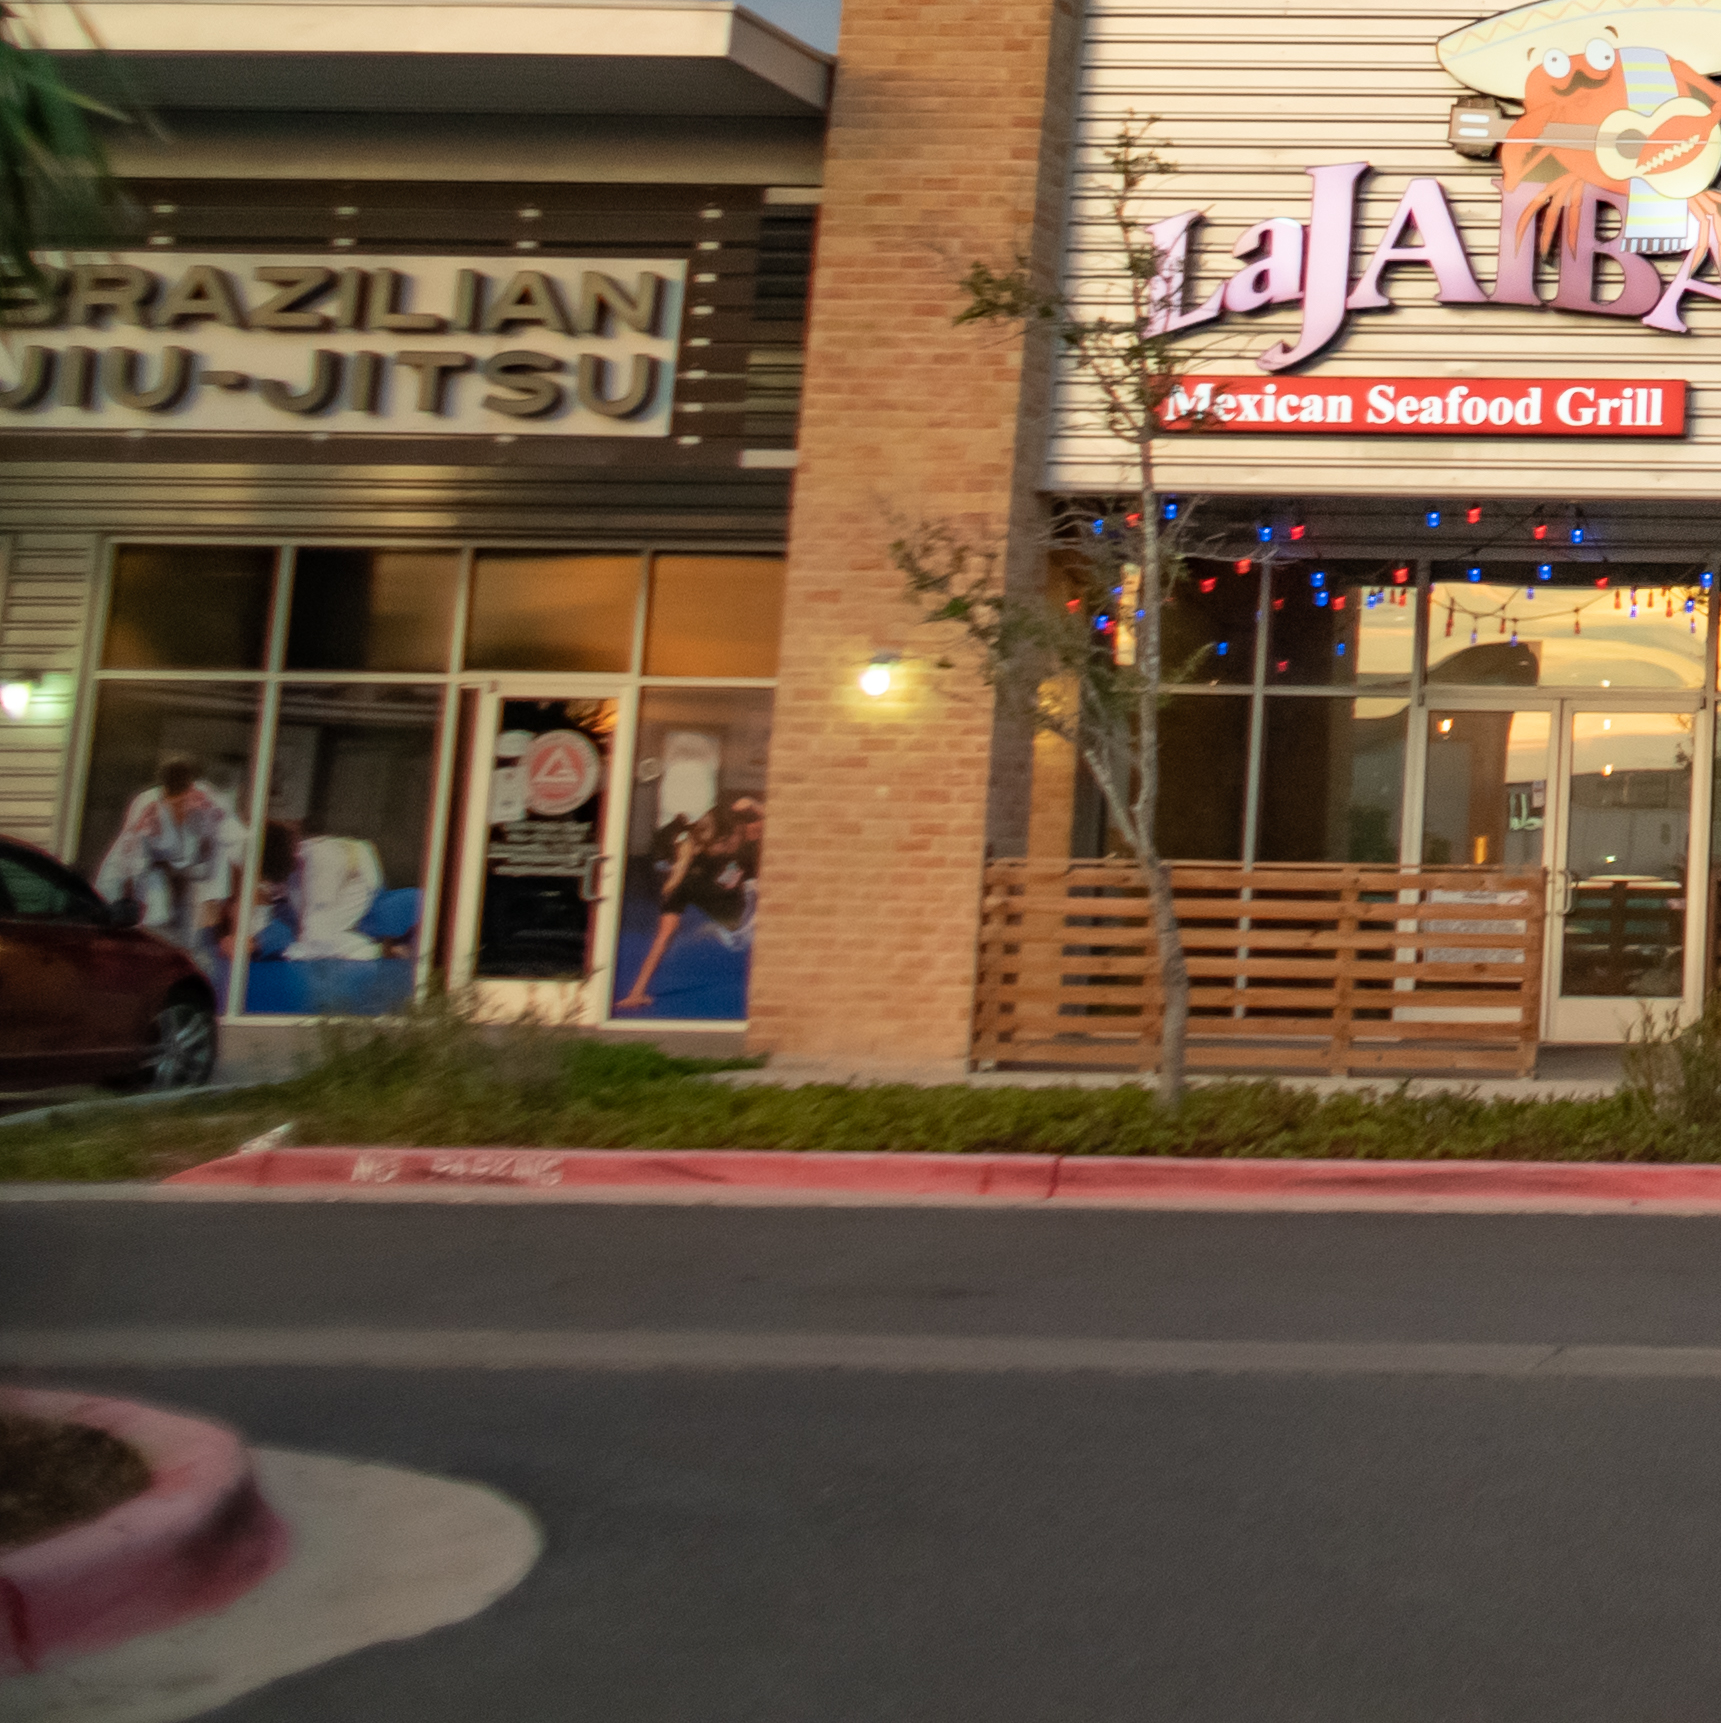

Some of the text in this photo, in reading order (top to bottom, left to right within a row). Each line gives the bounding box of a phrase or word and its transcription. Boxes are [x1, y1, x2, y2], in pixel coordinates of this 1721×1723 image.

[0, 344, 662, 420] JIU-JITSU
[1164, 382, 1664, 427] Mexican Seafood Grill
